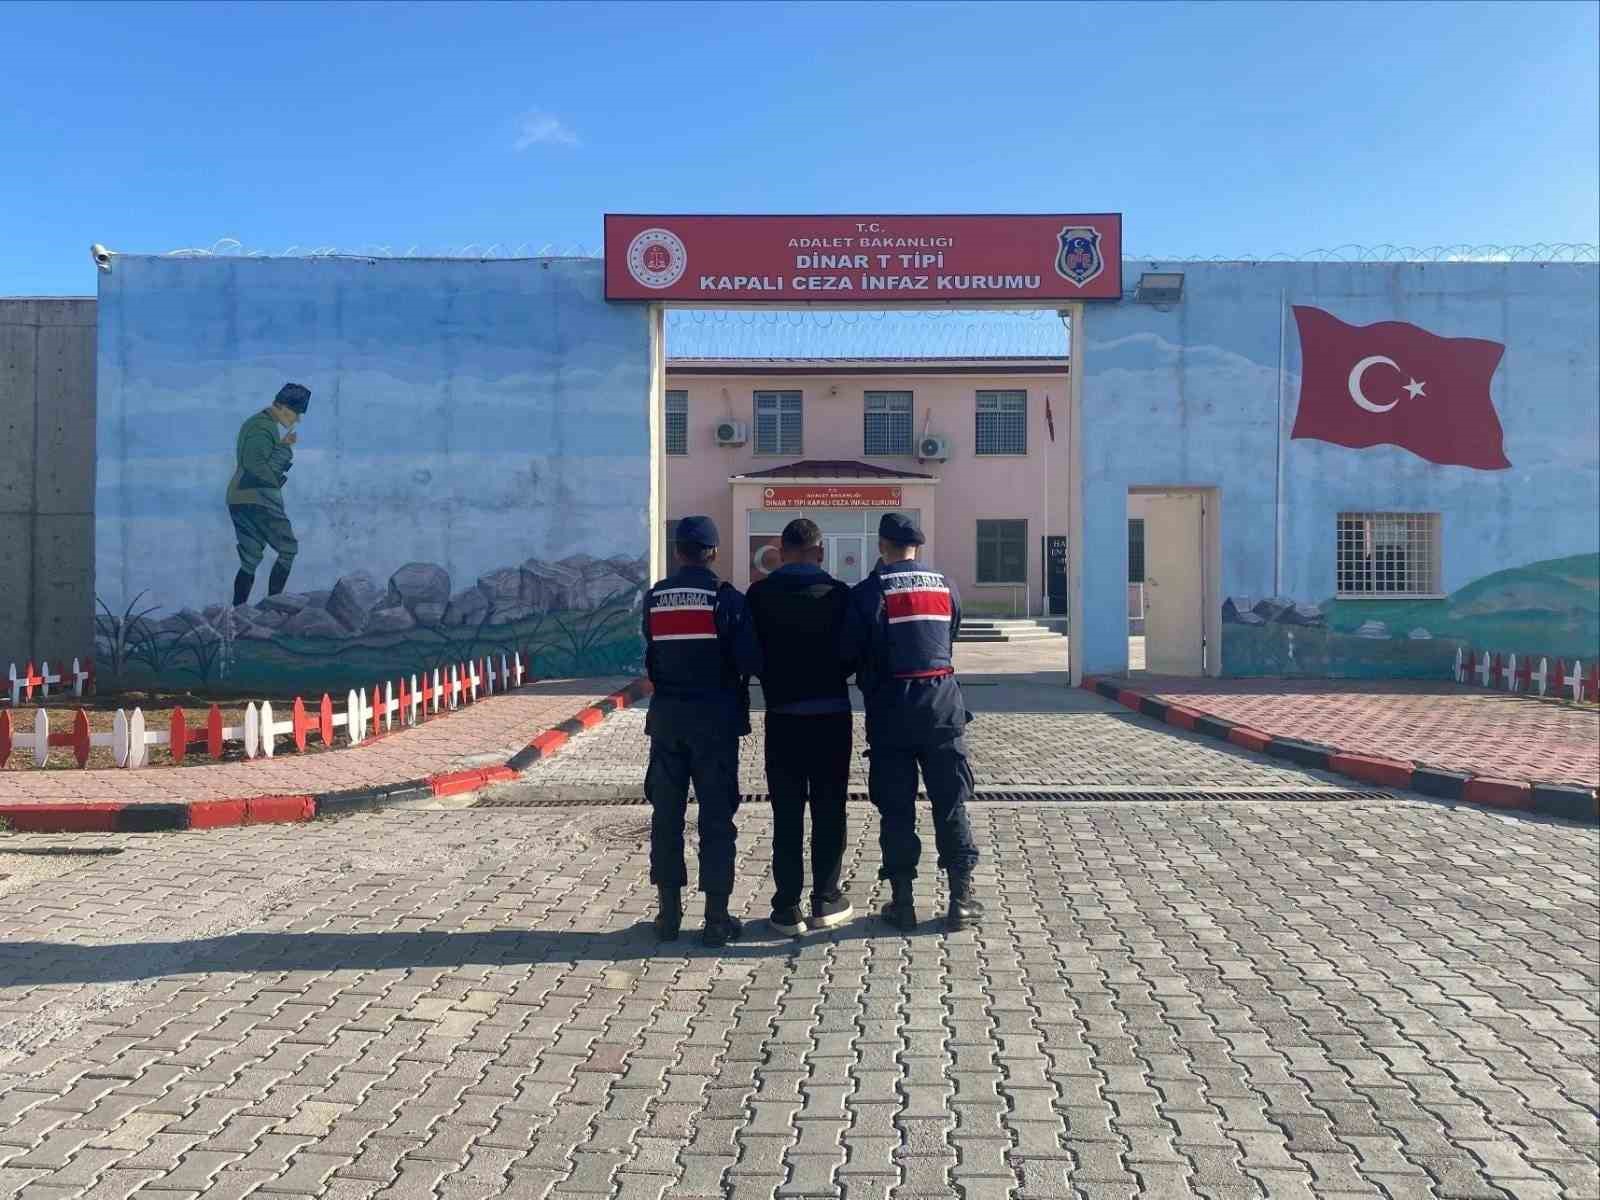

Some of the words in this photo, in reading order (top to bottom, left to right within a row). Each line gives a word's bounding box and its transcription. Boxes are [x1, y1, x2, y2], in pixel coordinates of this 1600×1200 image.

[856, 223, 885, 232] T.C.
[788, 238, 854, 248] ADALET
[860, 236, 953, 247] BAKANLIĞI
[796, 252, 869, 268] DİNAR
[877, 254, 890, 268] T
[898, 252, 944, 268] TİPİ
[700, 275, 784, 290] KAPALI
[792, 276, 853, 290] CEZA
[861, 273, 929, 290] İNFAZ
[937, 275, 1041, 289] KURUMU
[656, 592, 708, 608] JANDARMA
